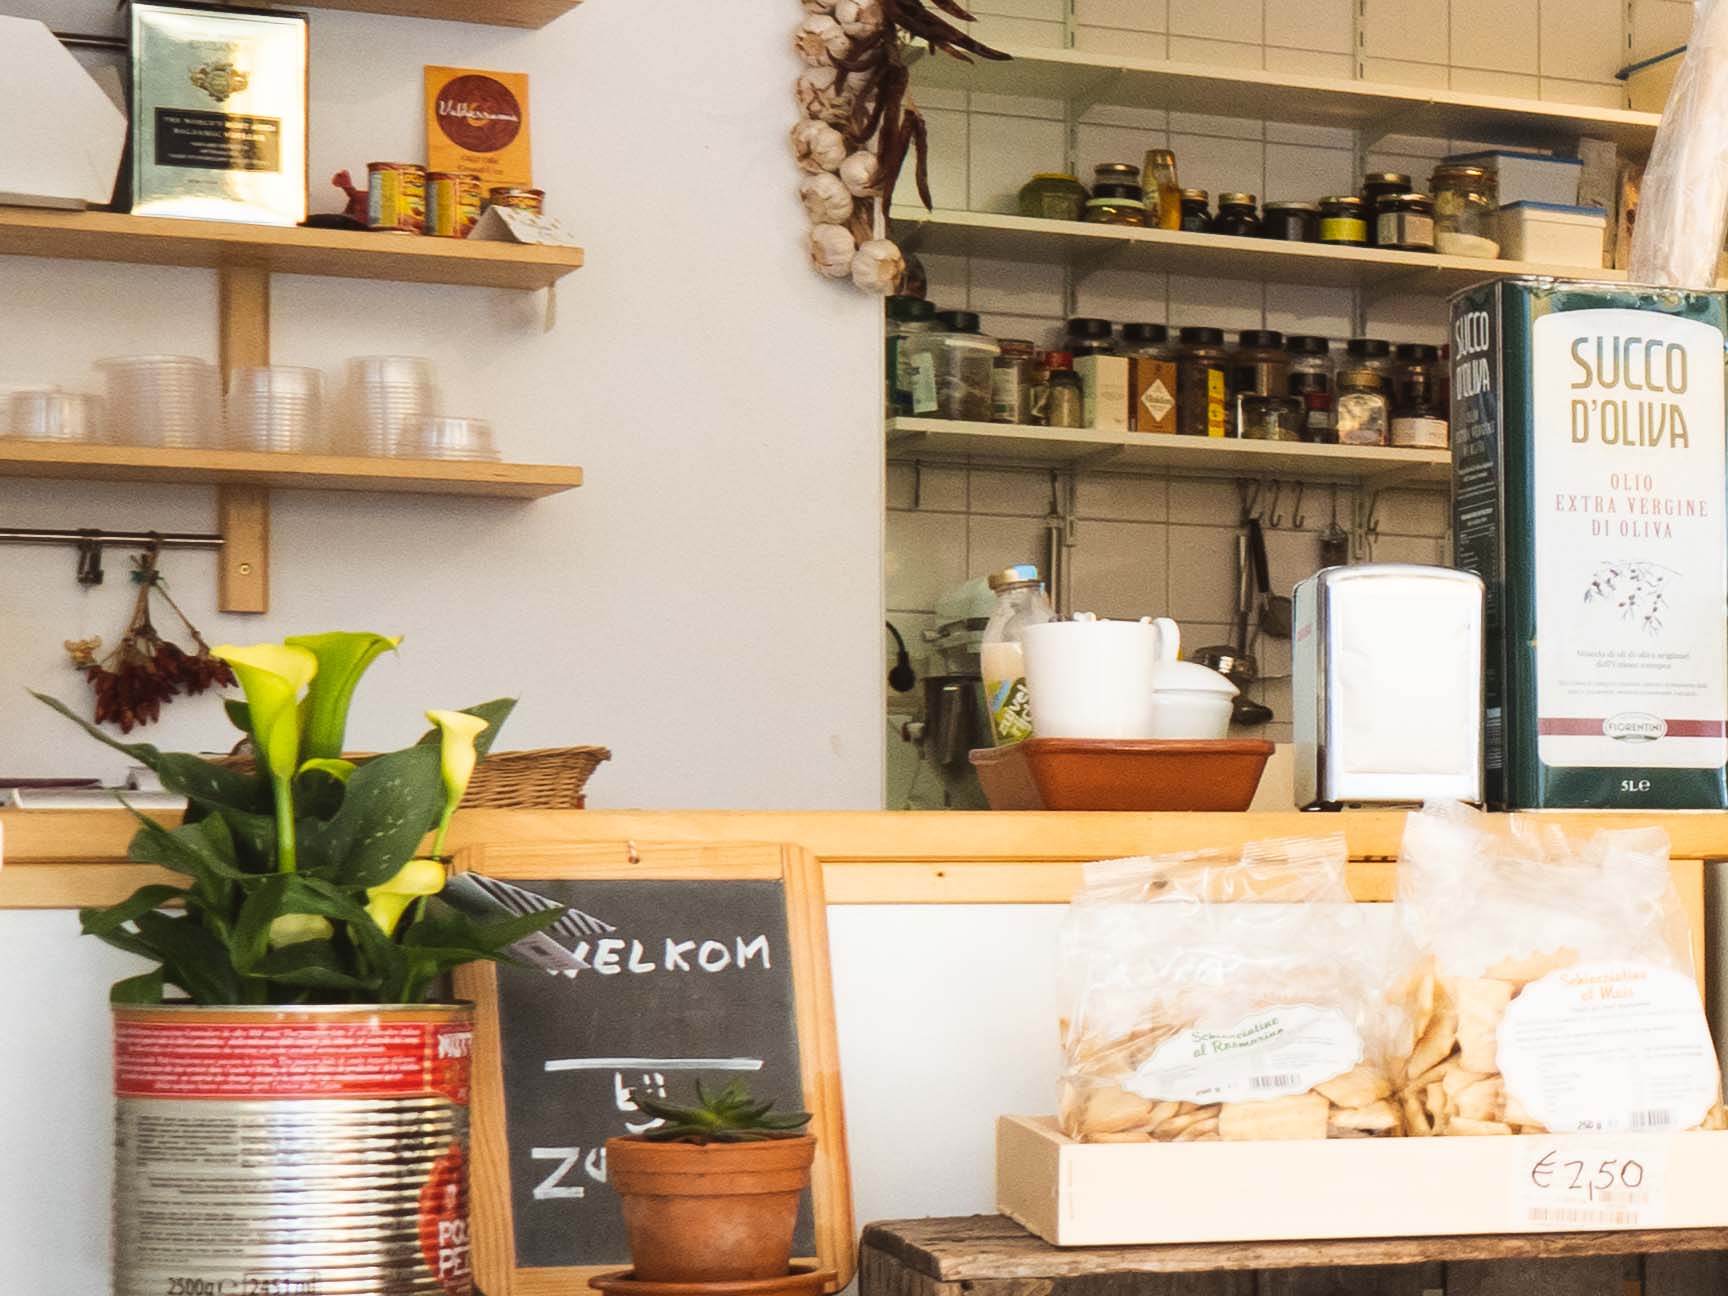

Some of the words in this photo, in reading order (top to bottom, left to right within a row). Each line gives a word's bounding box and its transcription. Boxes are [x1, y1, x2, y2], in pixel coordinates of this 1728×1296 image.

[1456, 311, 1489, 361] SUCCO
[1571, 335, 1688, 394] SUCCO
[1571, 399, 1690, 448] D'OLIVA
[1610, 473, 1653, 492] OLIO
[1555, 494, 1617, 513] EXTRA
[1627, 496, 1708, 517] VERGINE
[1592, 519, 1610, 537] DI
[1620, 520, 1673, 538] OLIVA
[1608, 722, 1662, 733] FIORENTINI
